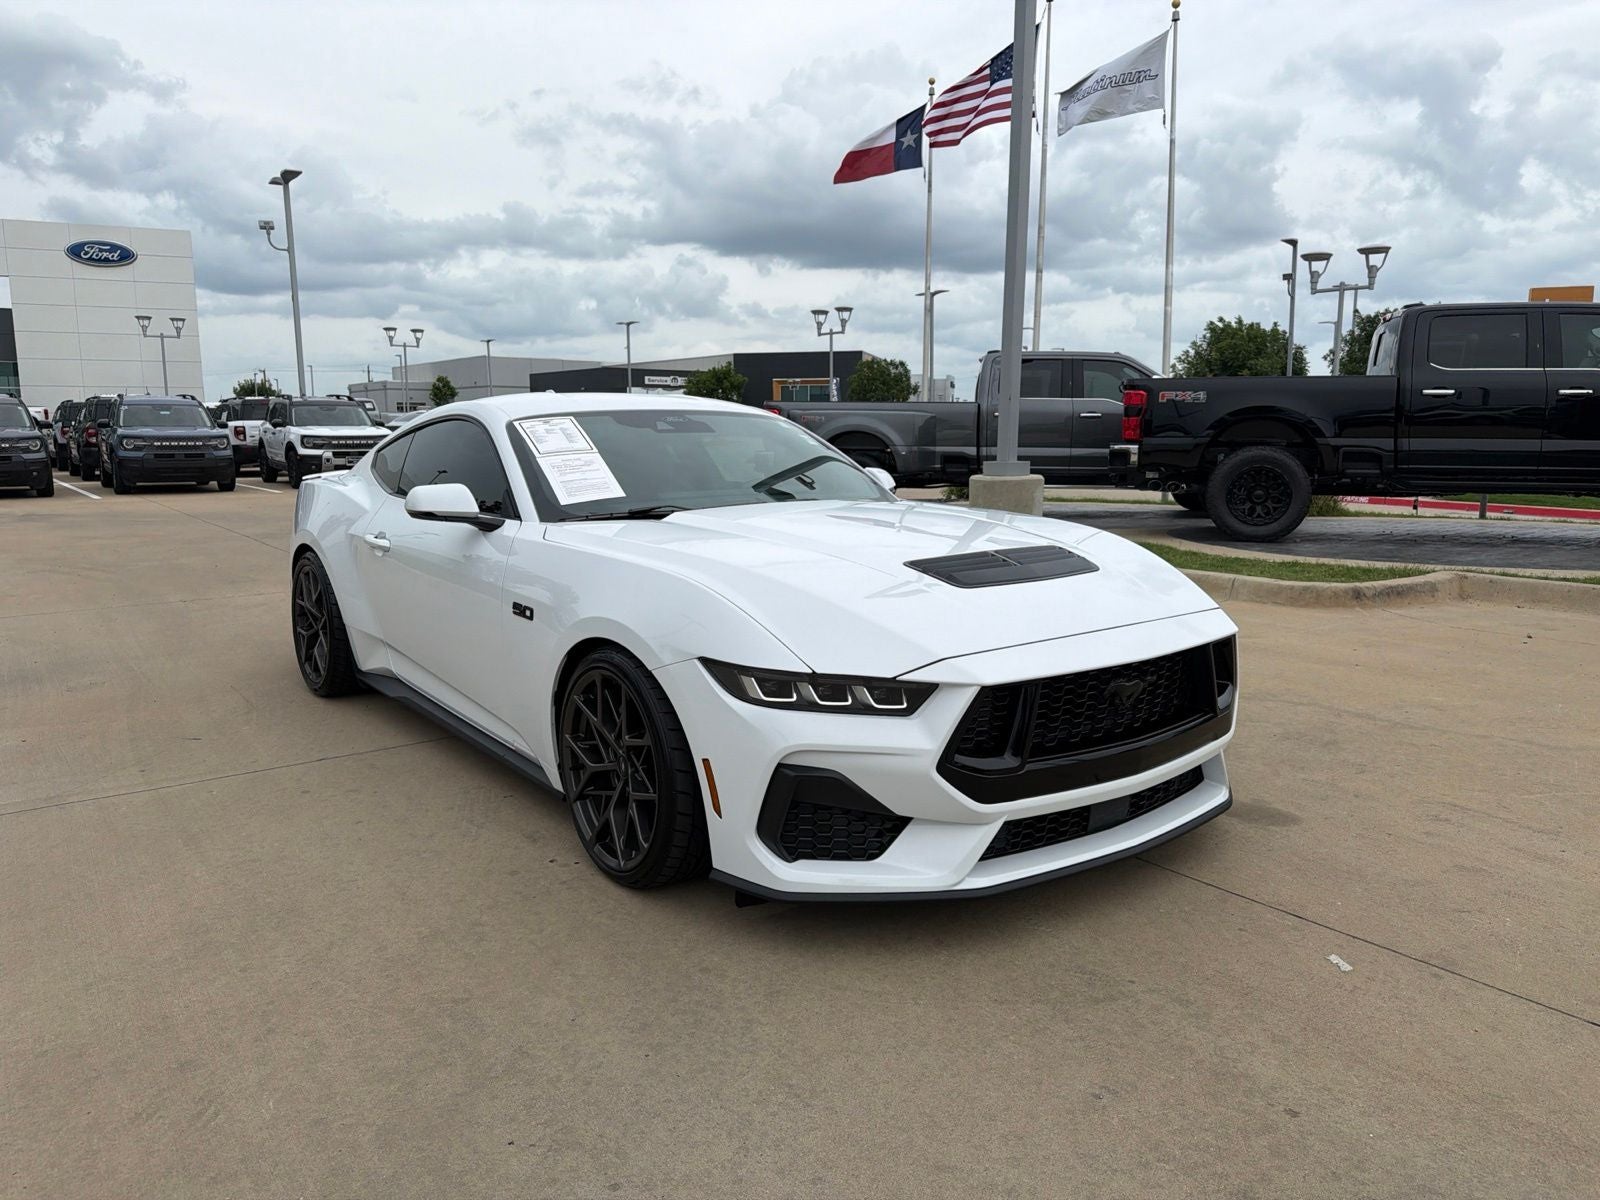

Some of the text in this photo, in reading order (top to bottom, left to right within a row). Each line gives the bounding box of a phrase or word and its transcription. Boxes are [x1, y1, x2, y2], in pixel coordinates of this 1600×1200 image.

[1061, 68, 1159, 112] atinum
[81, 244, 120, 261] Ford
[1158, 391, 1208, 403] FX4
